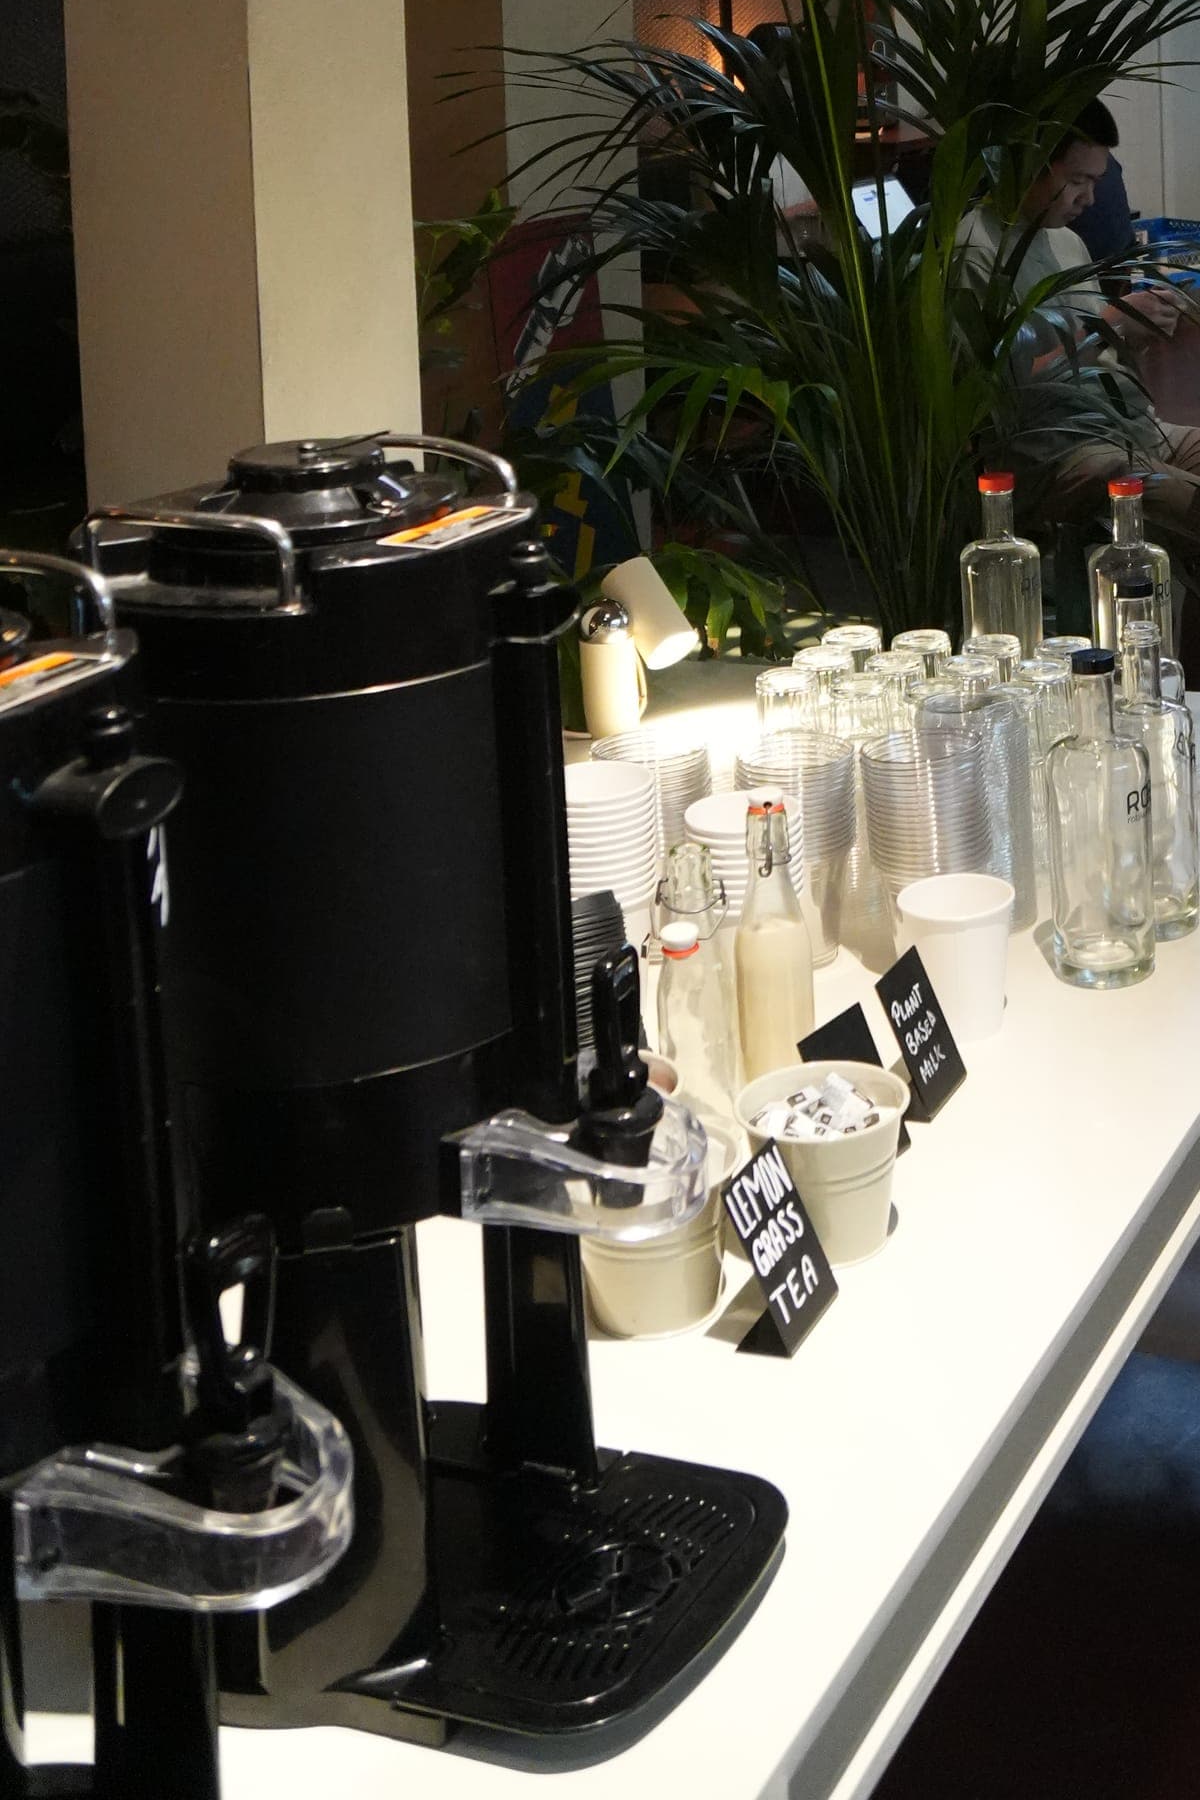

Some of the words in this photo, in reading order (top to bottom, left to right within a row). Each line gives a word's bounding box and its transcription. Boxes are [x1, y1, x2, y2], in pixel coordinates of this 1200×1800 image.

[891, 982, 922, 1028] PLANT
[905, 1009, 936, 1056] BASED
[919, 1044, 946, 1085] MILK
[726, 1145, 793, 1239] LEMON
[752, 1201, 804, 1277] GRASS
[769, 1254, 819, 1325] TEA
